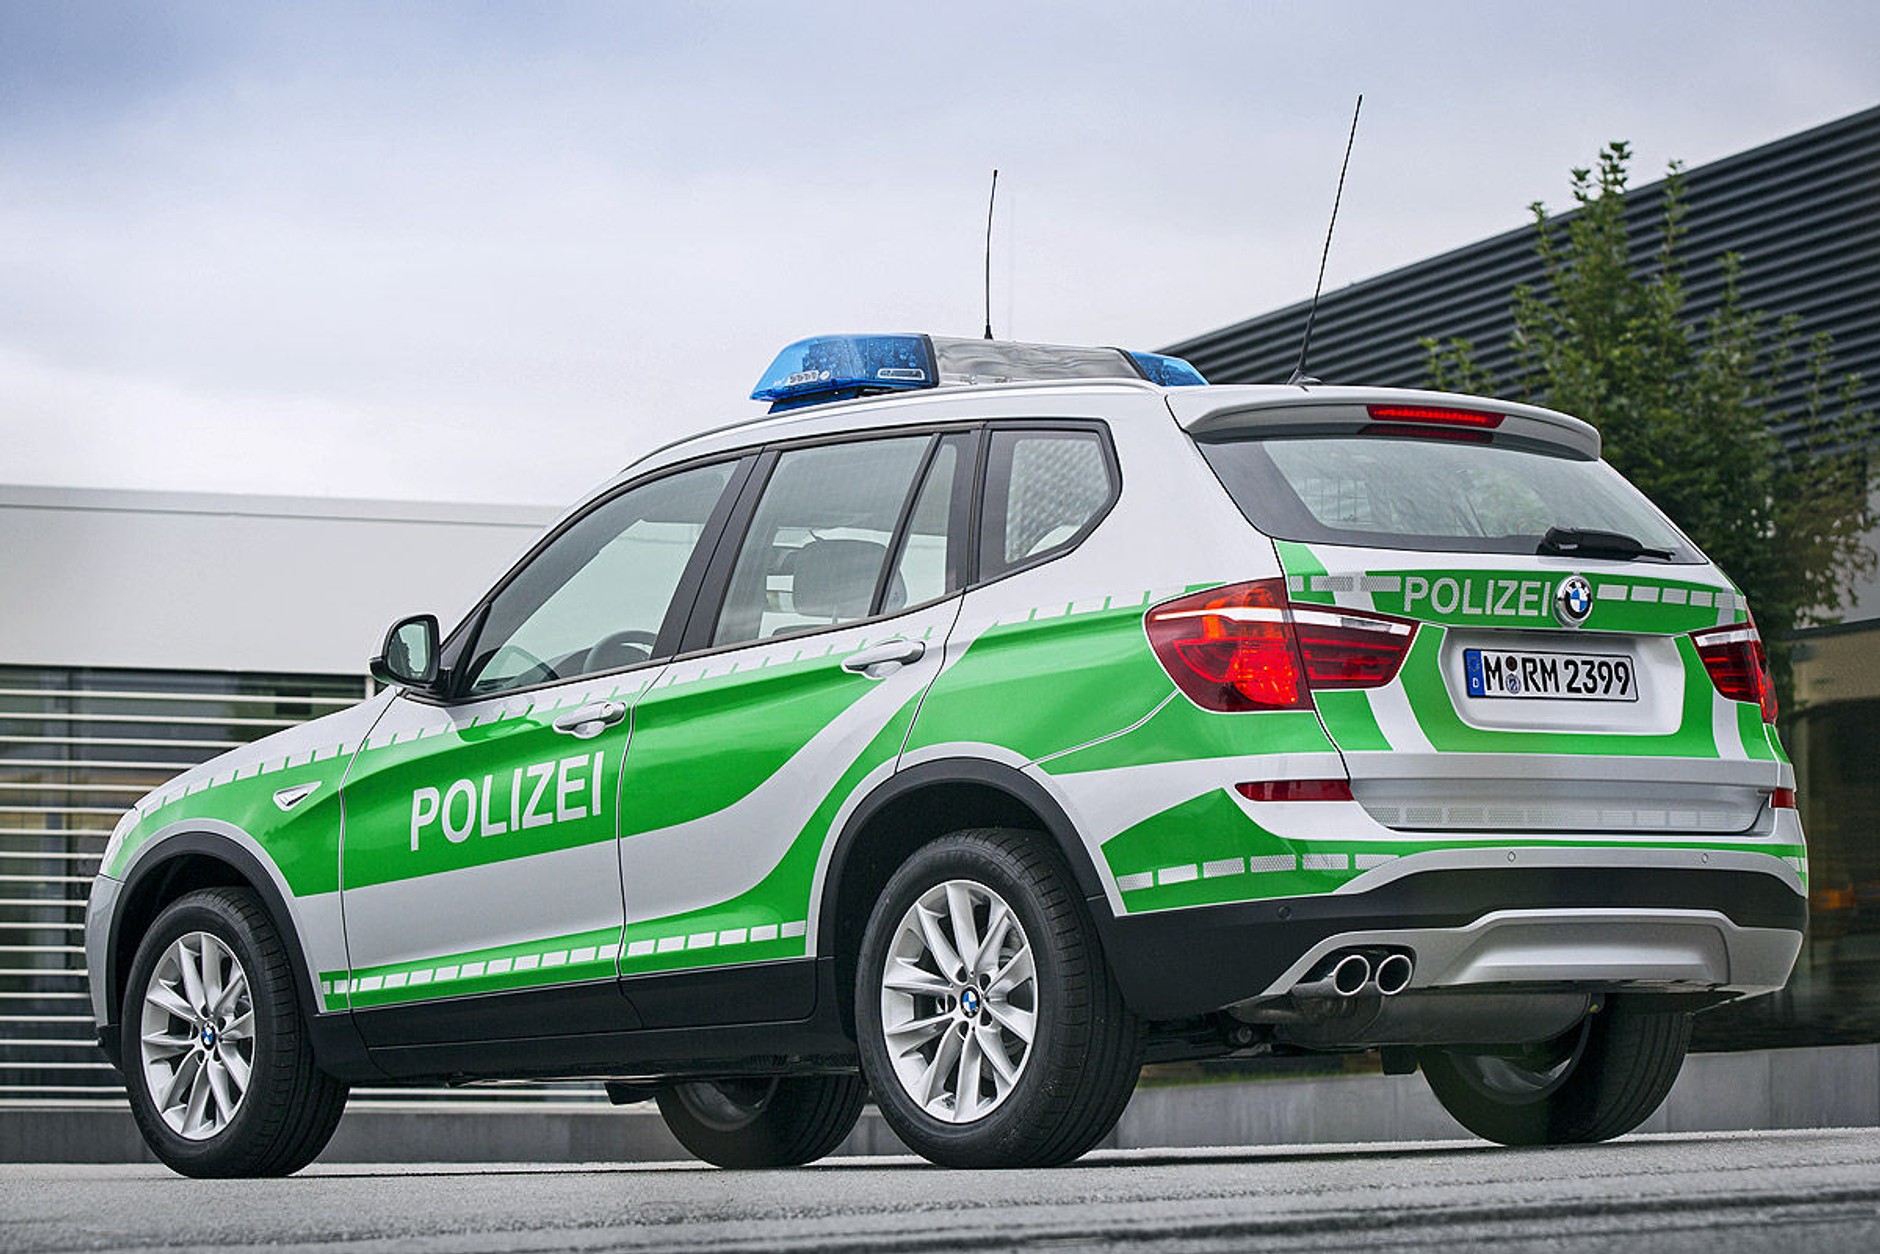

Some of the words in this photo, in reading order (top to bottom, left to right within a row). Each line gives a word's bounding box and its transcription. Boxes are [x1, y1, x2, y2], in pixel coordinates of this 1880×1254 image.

[1404, 576, 1551, 617] POLIZEI
[1483, 655, 1504, 691] M
[1521, 657, 1560, 693] RM
[1564, 659, 1630, 696] 2399
[410, 750, 605, 852] POLIZEI
